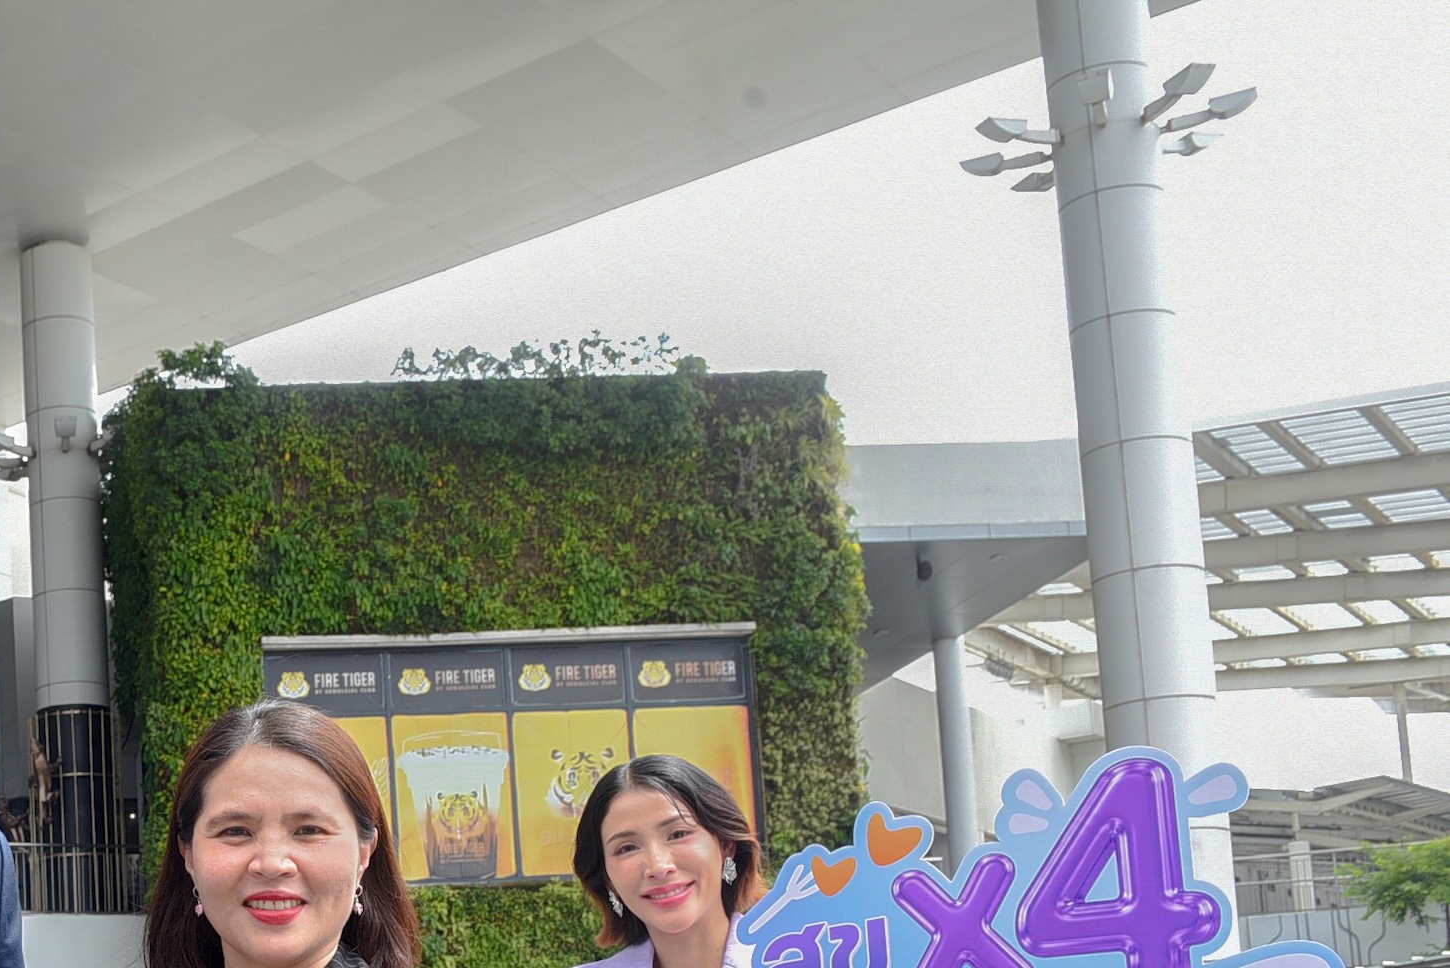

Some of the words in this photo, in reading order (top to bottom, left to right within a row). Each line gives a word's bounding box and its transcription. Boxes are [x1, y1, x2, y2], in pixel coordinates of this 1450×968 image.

[435, 670, 461, 686] FIRE
[462, 668, 496, 684] TIGER
[555, 665, 581, 681] FIRE
[582, 663, 617, 680] TIGER
[674, 661, 701, 678] FIRE
[703, 660, 736, 676] TIGER
[314, 672, 340, 688] FIRE
[342, 671, 376, 687] TIGER
